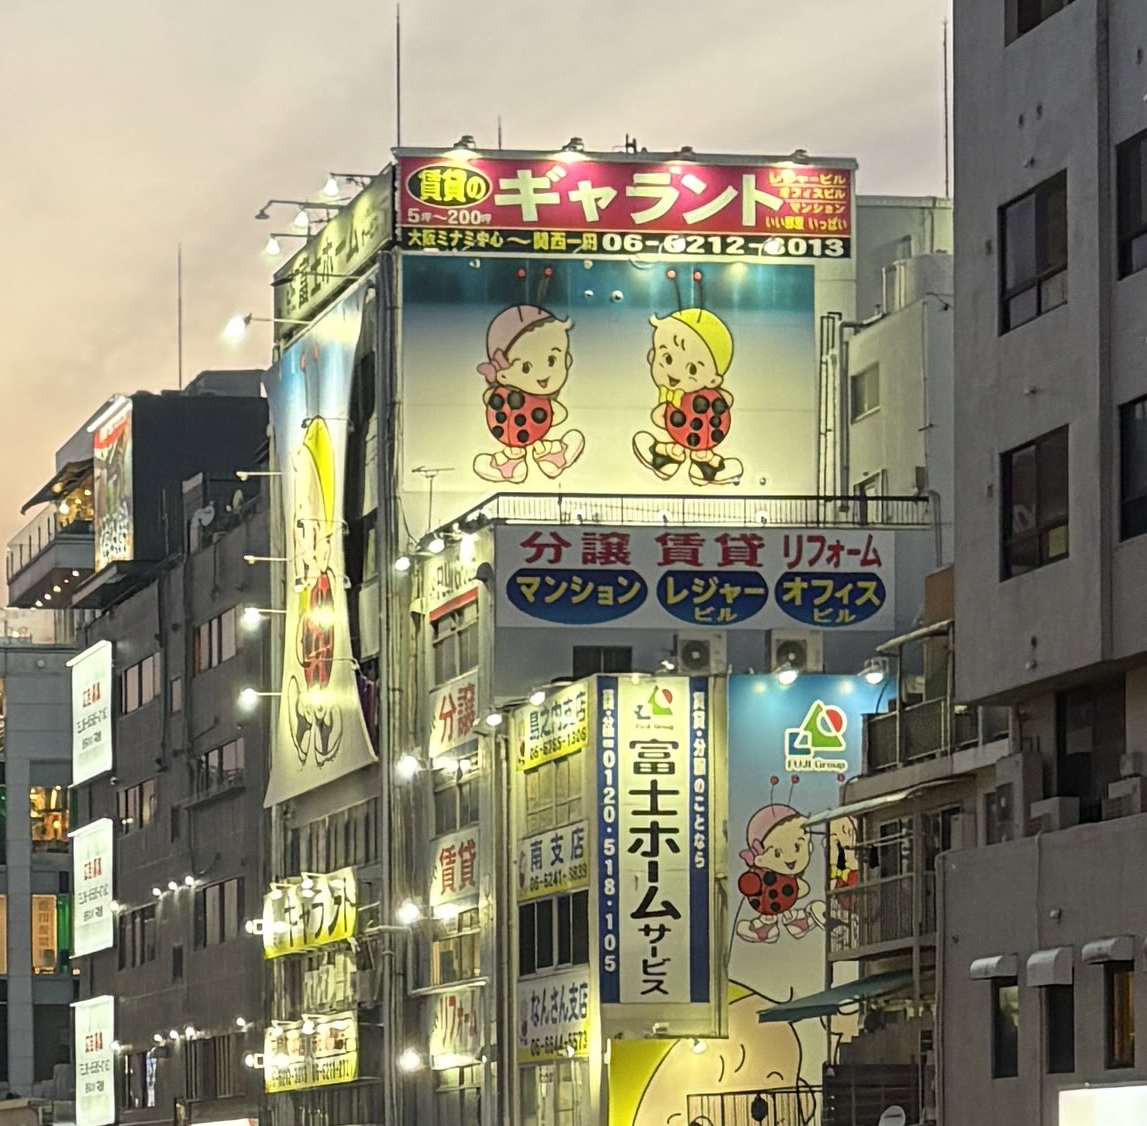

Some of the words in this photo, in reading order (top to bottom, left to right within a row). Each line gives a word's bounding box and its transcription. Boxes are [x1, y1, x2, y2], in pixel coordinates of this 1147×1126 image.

[768, 169, 847, 186] レャービル
[494, 165, 784, 227] ギャラント
[783, 533, 883, 570] リフォーム
[516, 575, 641, 606] マンション
[667, 575, 765, 606] レジャー
[782, 576, 881, 607] オフィス
[694, 606, 738, 622] ビル
[813, 607, 857, 623] ビル
[529, 826, 585, 873] 南支店
[439, 838, 476, 896] 賃貸
[627, 738, 682, 995] 富士ホームサービス
